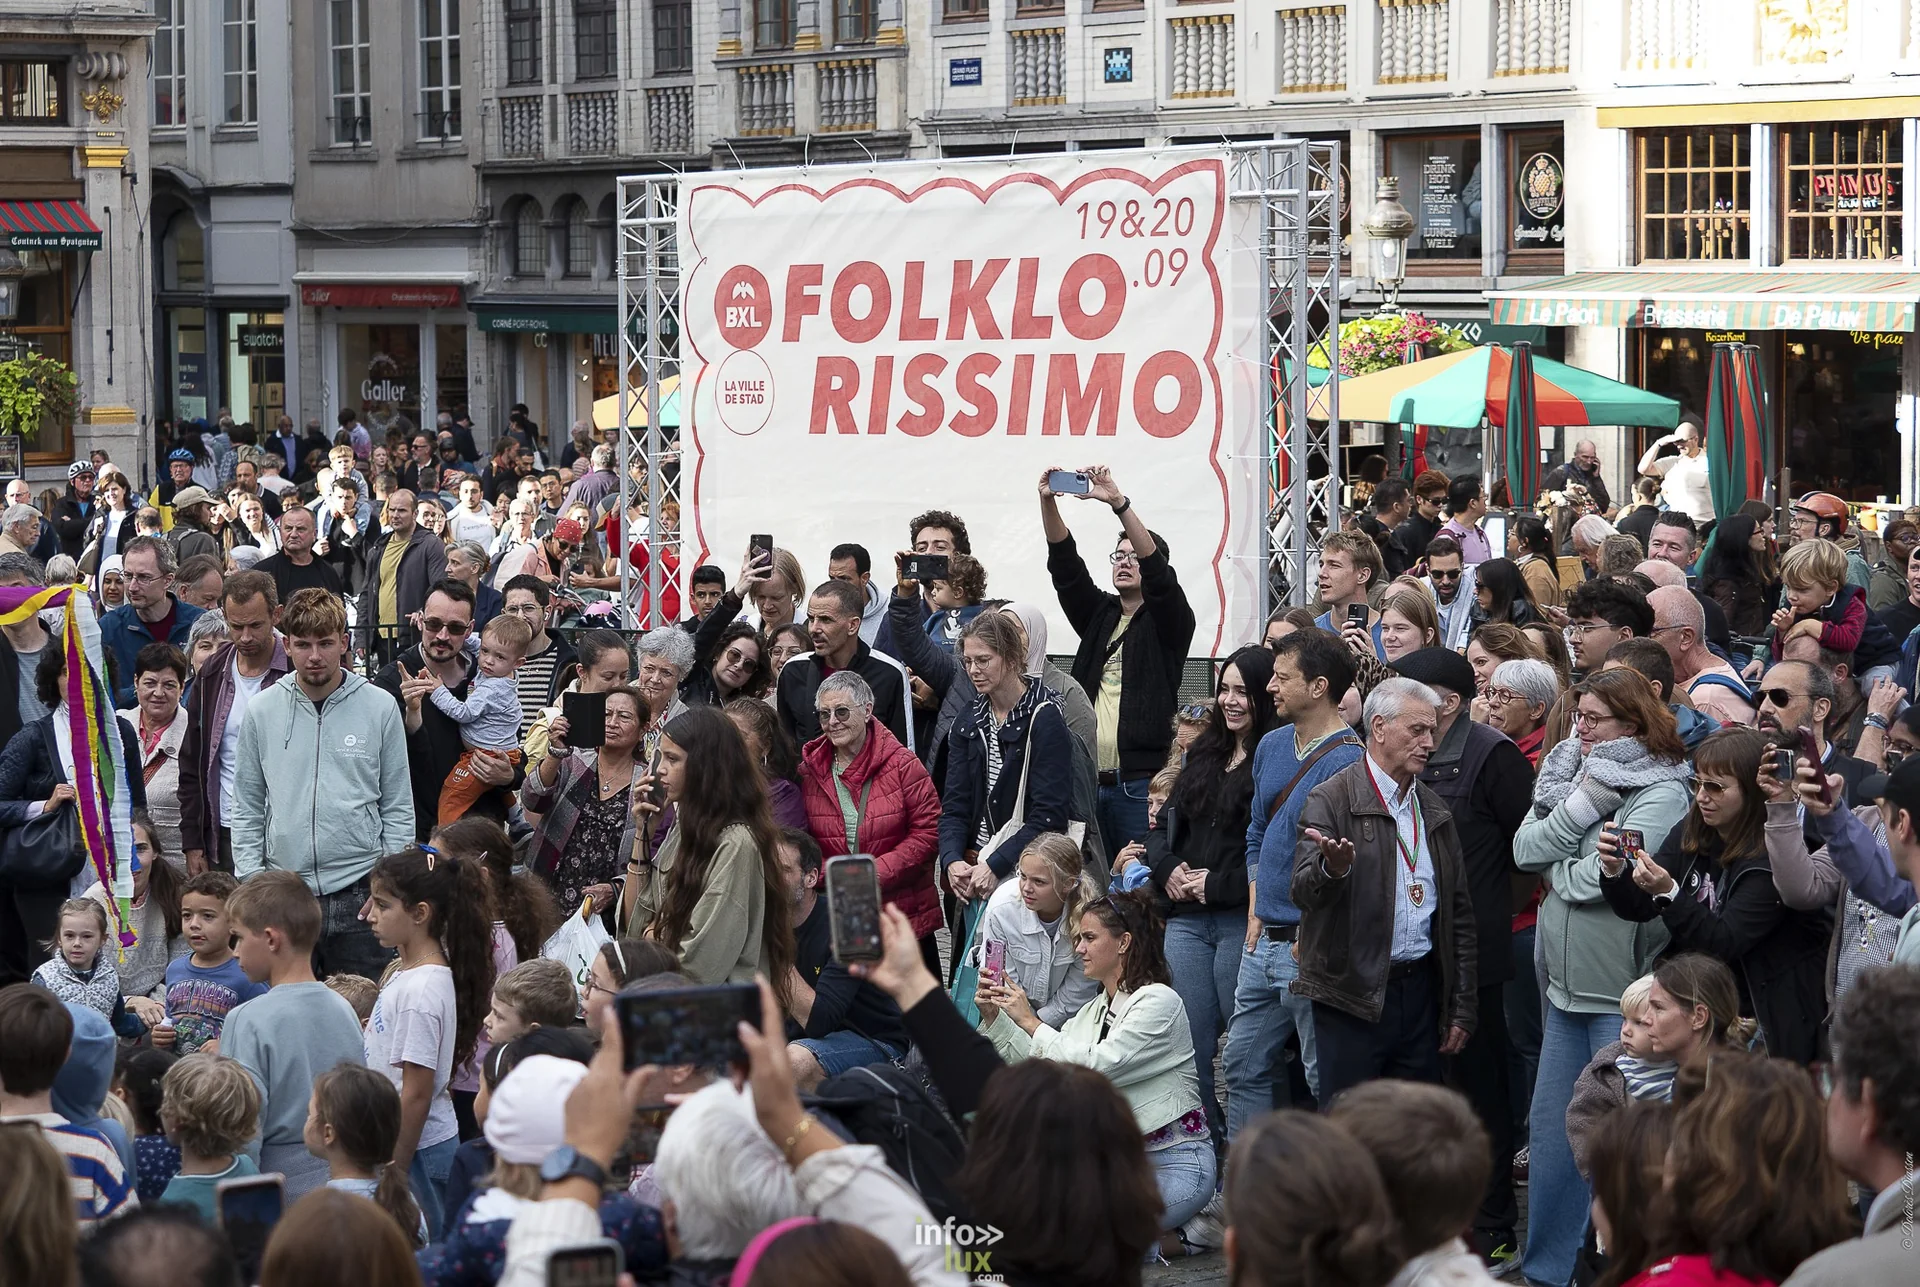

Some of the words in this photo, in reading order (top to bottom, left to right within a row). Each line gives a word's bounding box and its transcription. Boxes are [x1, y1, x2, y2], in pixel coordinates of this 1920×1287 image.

[1423, 164, 1456, 174] DRINK
[1428, 174, 1451, 184] HOT
[1423, 194, 1457, 203] BREAK
[1427, 204, 1453, 214] FAST
[1077, 197, 1194, 239] 19&20
[1423, 227, 1457, 238] LUNCH
[1426, 238, 1455, 249] WELL
[1133, 248, 1188, 287] .09
[726, 306, 762, 328] BXL
[1529, 302, 1552, 323] Le
[1555, 302, 1599, 325] Paon
[1644, 303, 1727, 328] Brasserie
[1774, 304, 1802, 327] De
[1804, 304, 1861, 329] Pauw
[243, 333, 278, 347] swatch
[361, 379, 406, 401] Galler
[725, 381, 736, 391] LA
[738, 381, 765, 391] VILLE
[725, 394, 737, 404] DE
[739, 394, 764, 404] STAD
[809, 350, 1203, 438] RISSIMO
